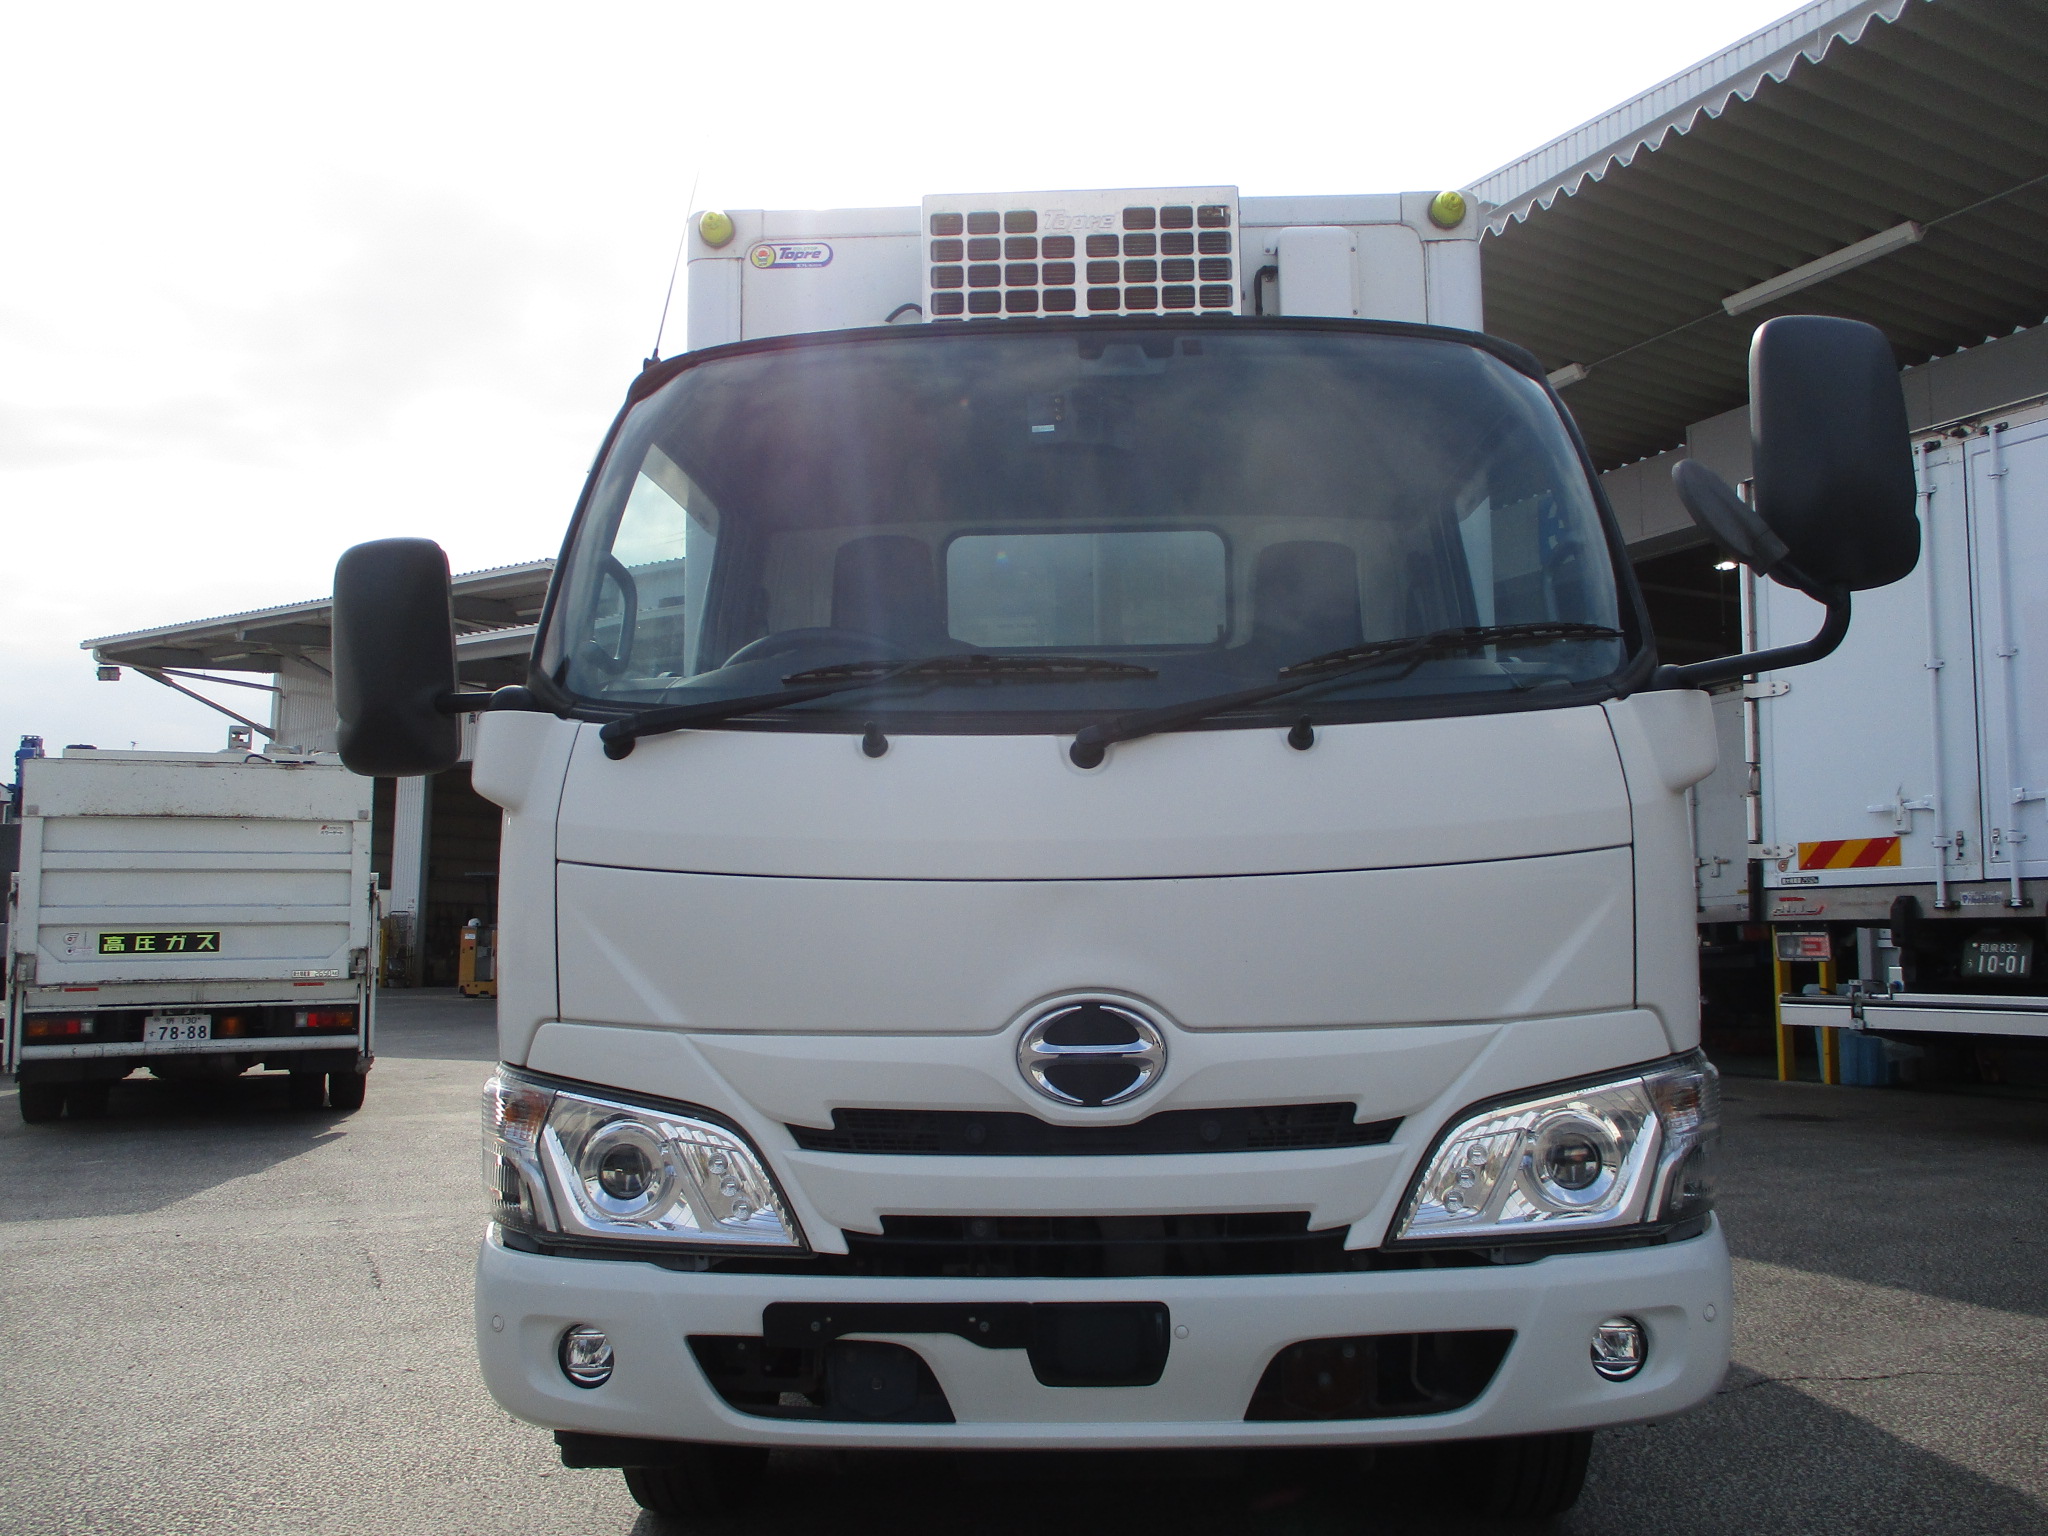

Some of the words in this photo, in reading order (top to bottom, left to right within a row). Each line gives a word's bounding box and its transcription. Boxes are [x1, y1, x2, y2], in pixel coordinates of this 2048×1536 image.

[1044, 209, 1115, 232] Topre
[779, 247, 822, 260] Topre
[103, 934, 215, 952] 高圧ガス
[1978, 955, 2025, 974] 10-01
[181, 1016, 197, 1025] 130
[159, 1025, 207, 1040] 78-88
